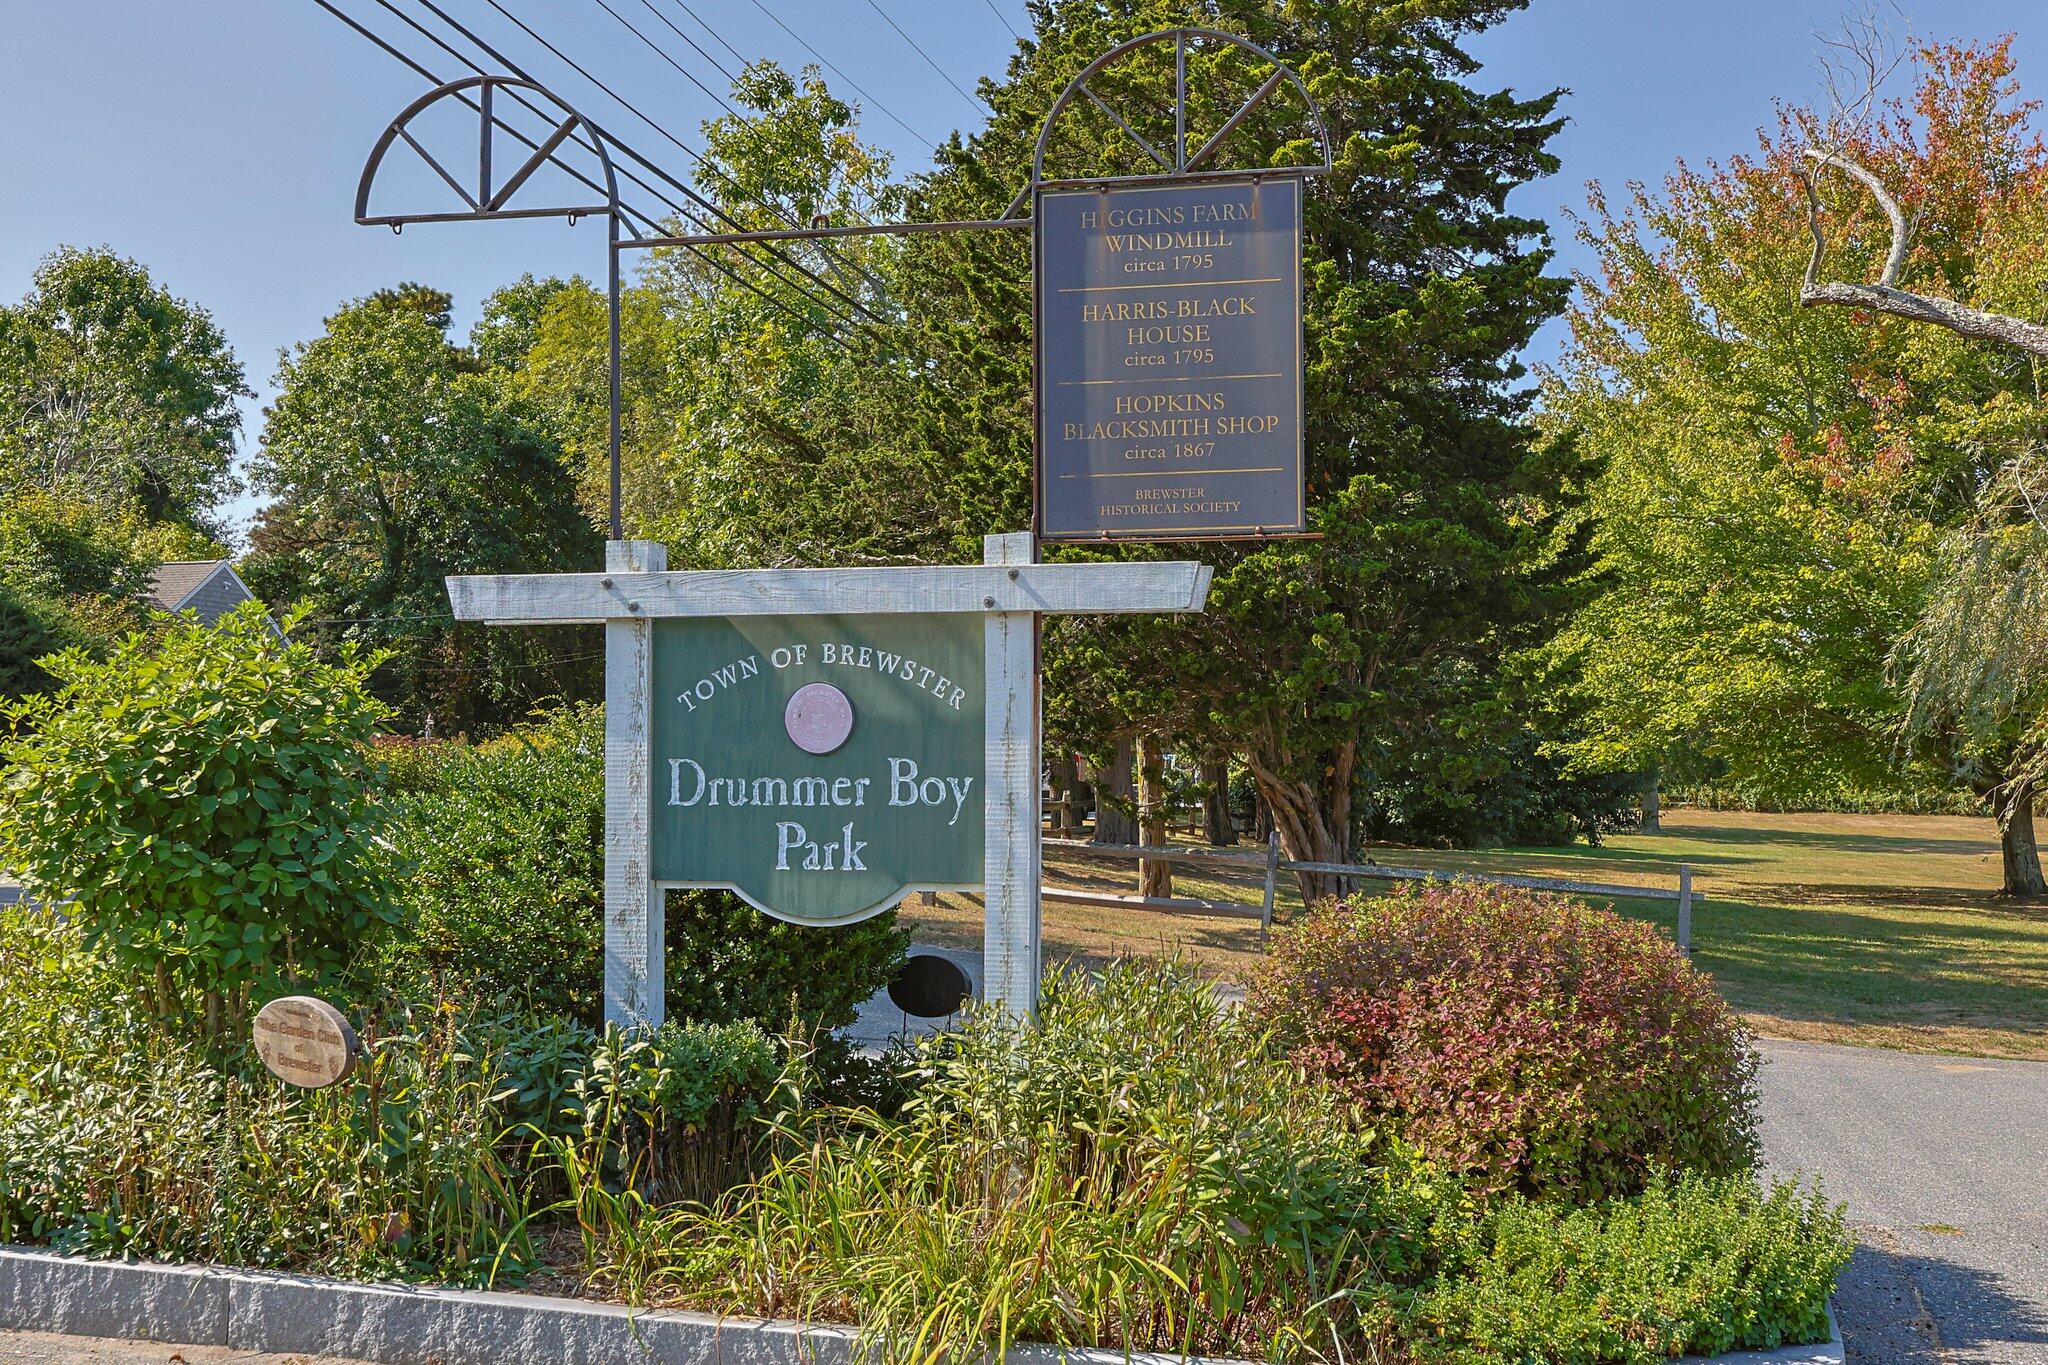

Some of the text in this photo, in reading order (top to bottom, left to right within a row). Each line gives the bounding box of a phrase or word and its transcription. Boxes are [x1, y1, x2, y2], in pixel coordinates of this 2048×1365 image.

[1080, 202, 1257, 229] HIGGINS FARM
[1105, 230, 1233, 252] WINDMILL
[1124, 254, 1214, 273] circa 1795
[1081, 297, 1257, 322] HARRIS-BLACK
[1127, 324, 1211, 345] HOUSE
[1124, 348, 1214, 367] circa 1795
[1115, 392, 1225, 414] HOPKINS
[1063, 415, 1280, 441] BLACKSMITH SHOP
[1125, 442, 1215, 460] circa 1867
[1135, 488, 1206, 500] BREWSTER
[1100, 501, 1241, 516] HISTORICAL SOCIETY
[677, 643, 967, 713] TOWN OF BREWSTER
[667, 757, 974, 826] Drummer Boy
[775, 821, 868, 871] Park
[294, 1043, 304, 1054] of
[277, 1052, 323, 1074] Brewster
